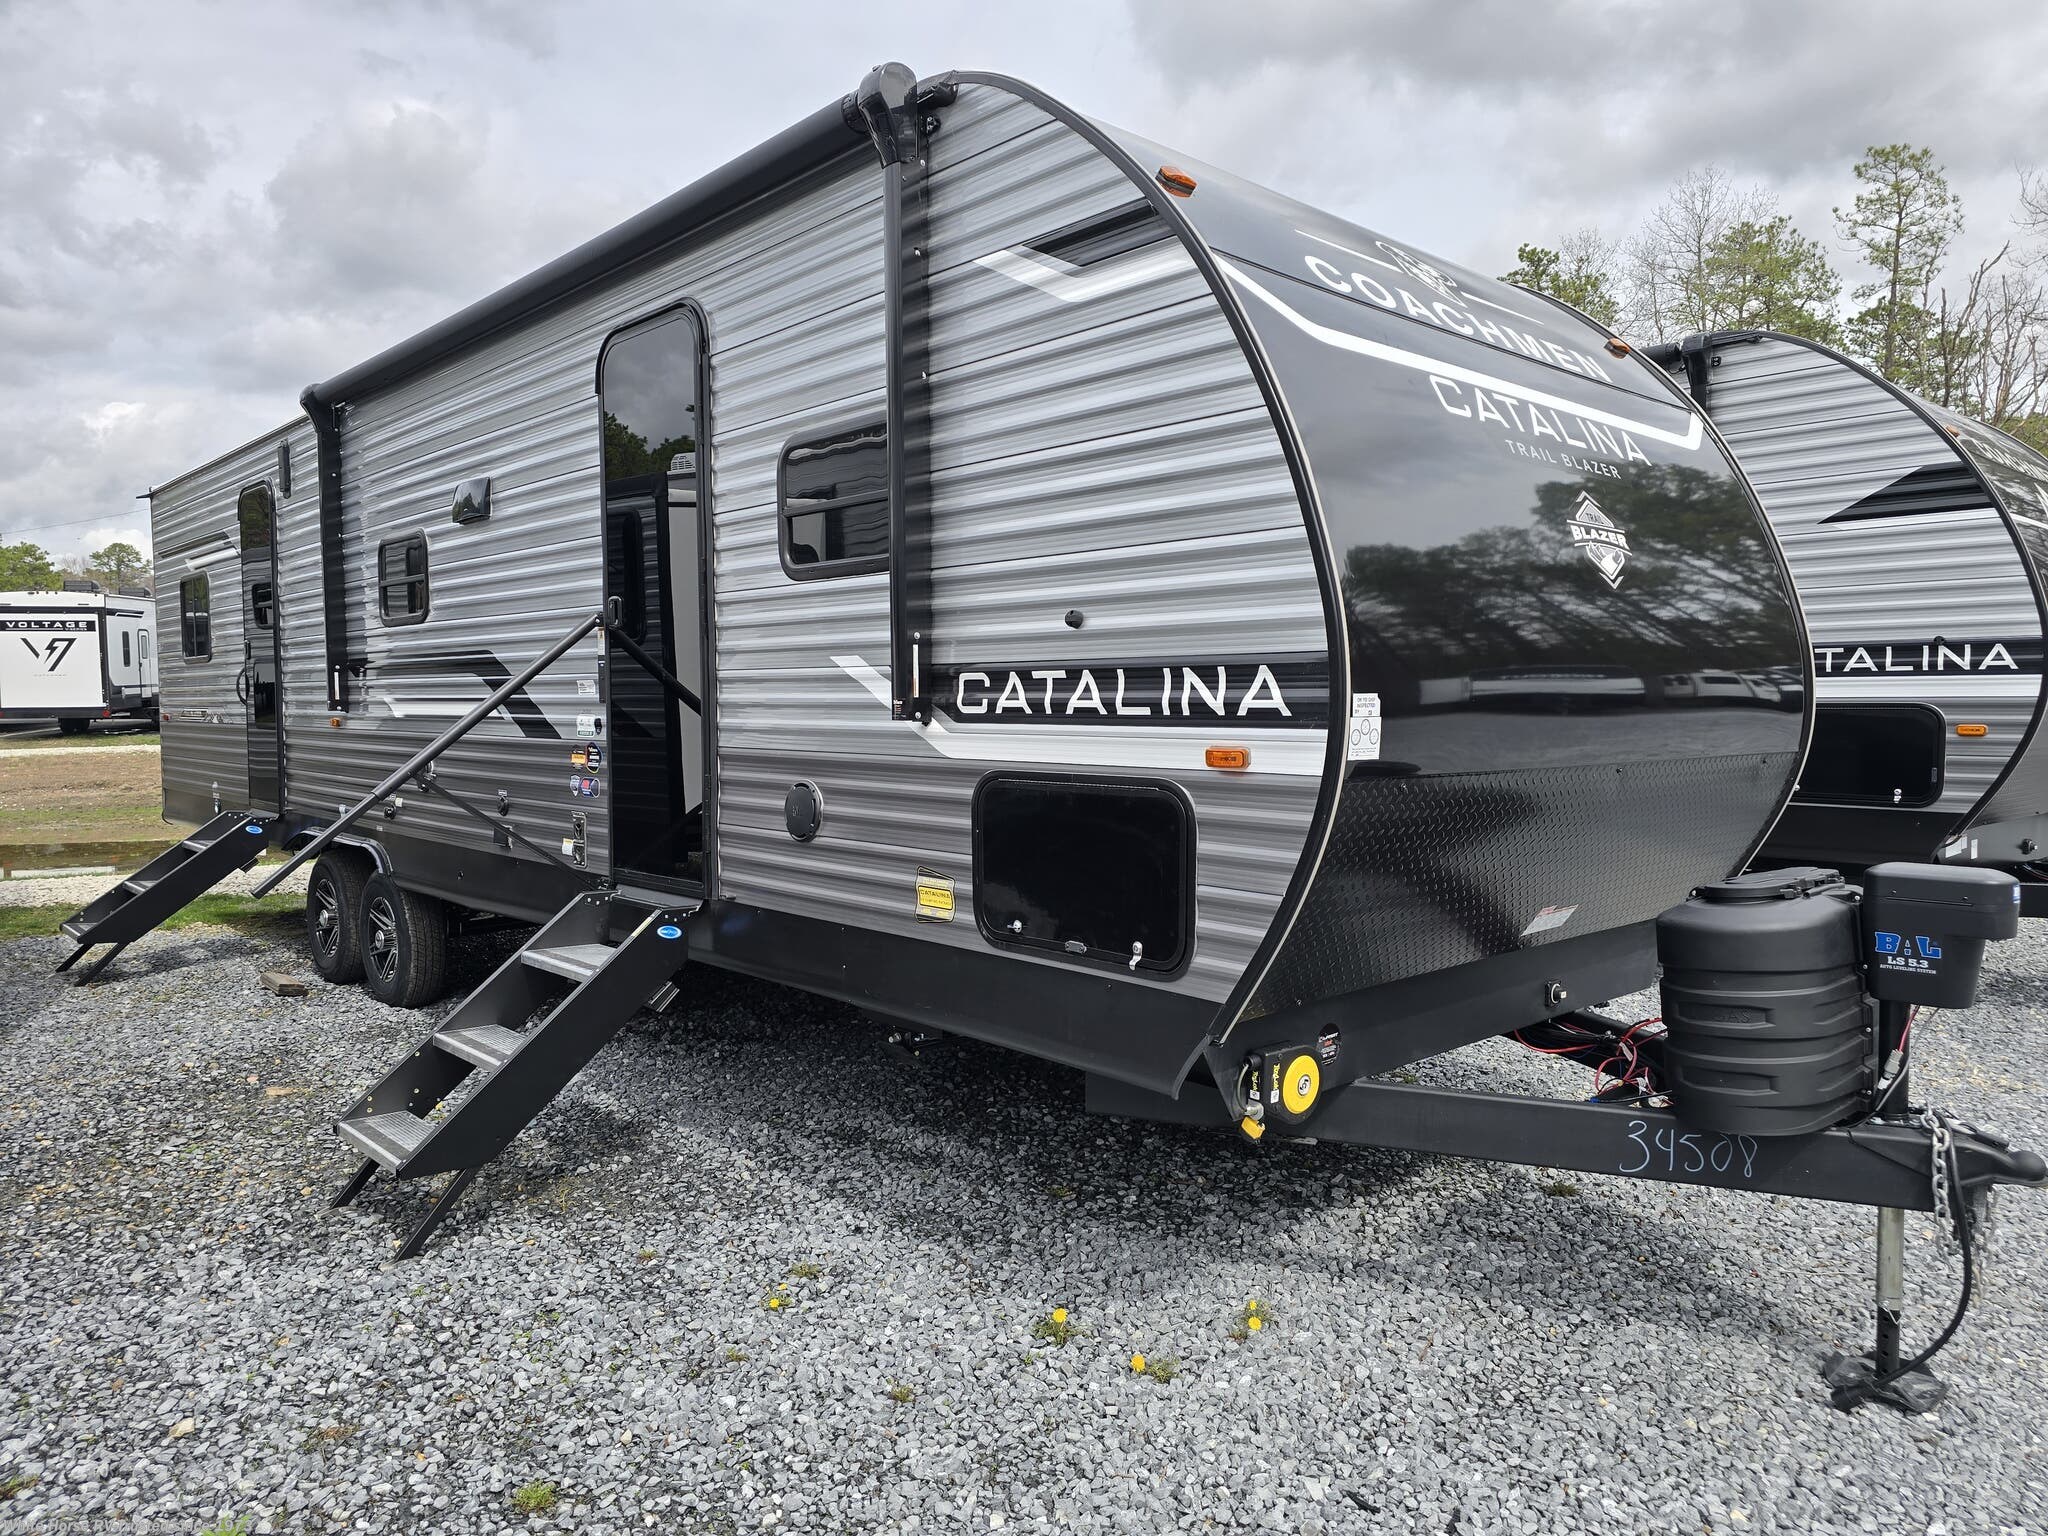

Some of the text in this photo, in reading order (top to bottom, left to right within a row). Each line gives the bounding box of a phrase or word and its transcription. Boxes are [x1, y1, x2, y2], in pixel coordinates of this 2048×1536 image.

[1305, 255, 1615, 383] COACHMEN
[1429, 374, 1653, 466] CATALINA
[1504, 439, 1622, 479] TRAIL BLAZER
[1570, 525, 1631, 551] BLAZER
[1814, 643, 2020, 672] TALINA
[956, 664, 1293, 717] CATALINA
[1887, 956, 1929, 968] LS 5.3
[1618, 1120, 1758, 1178] 34508
